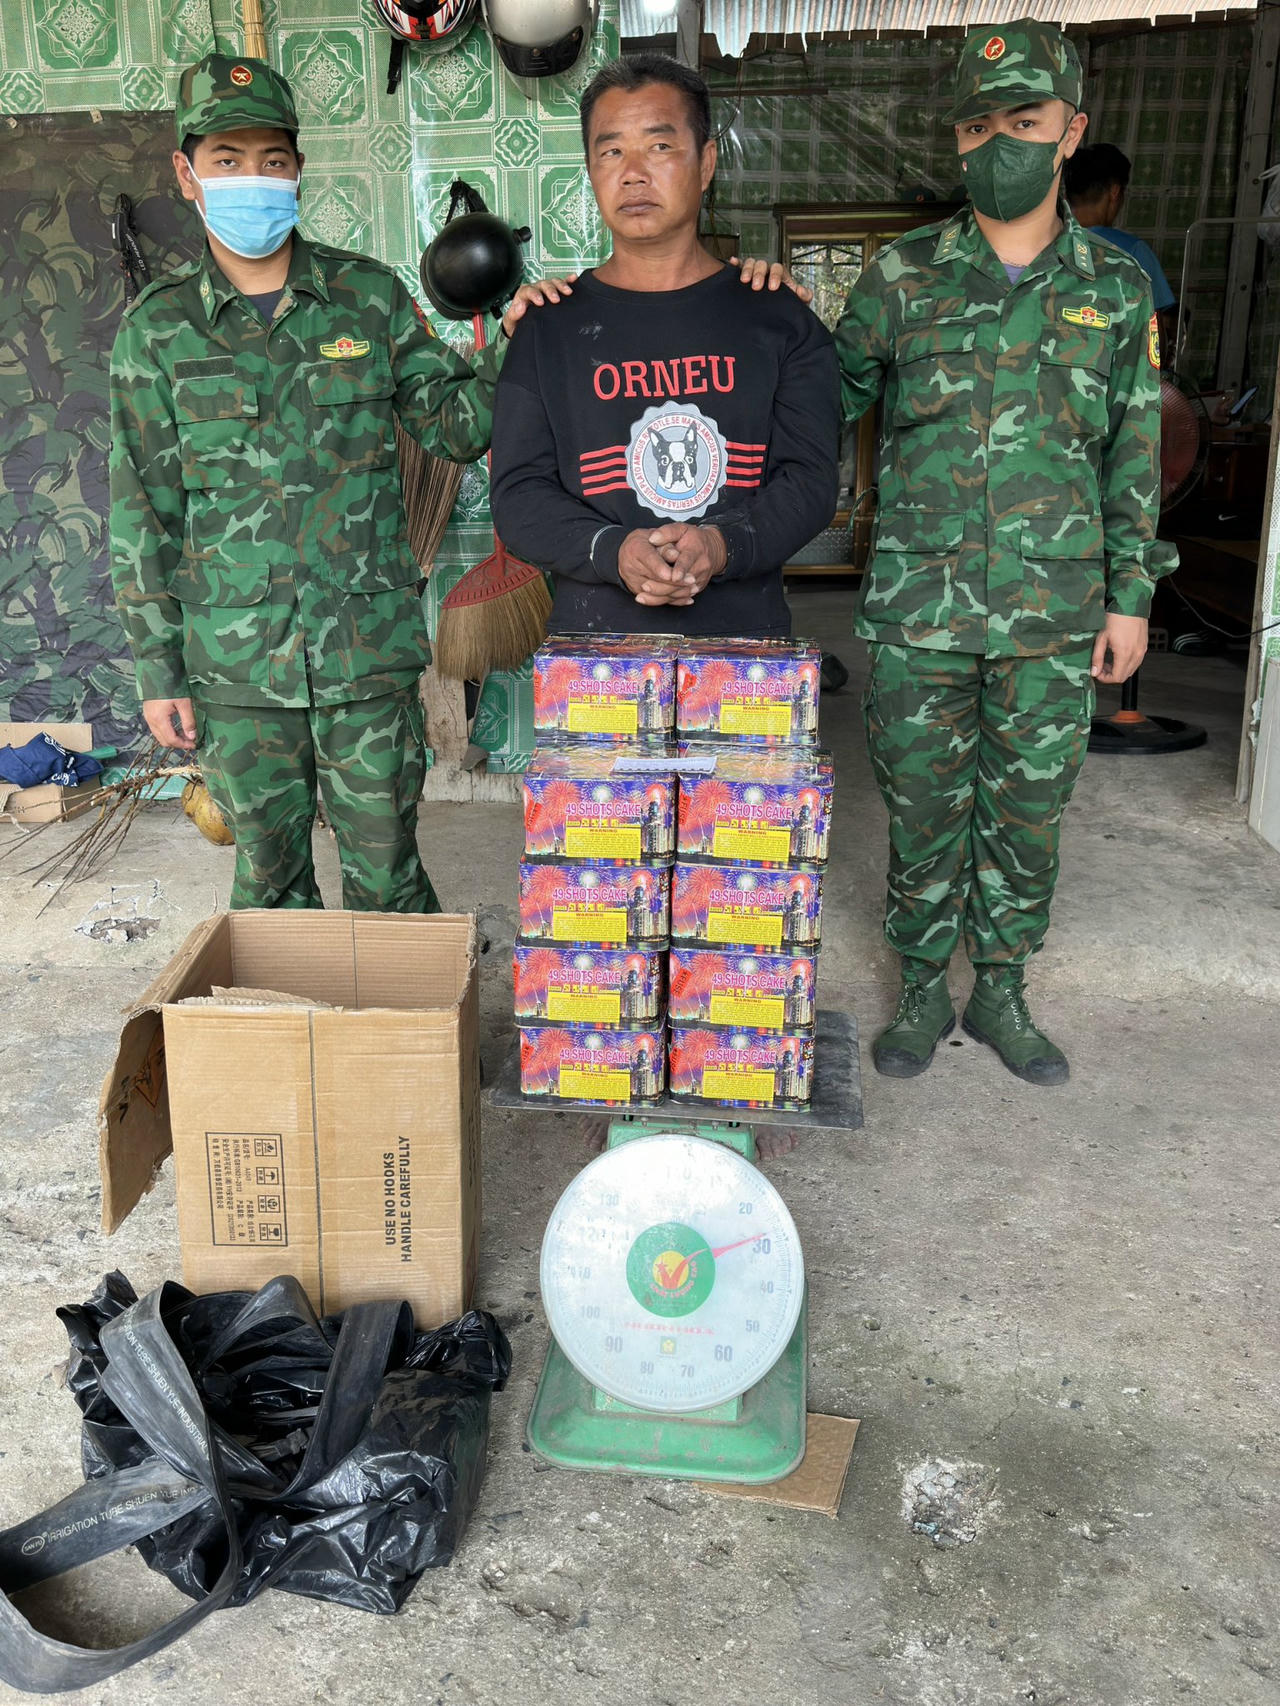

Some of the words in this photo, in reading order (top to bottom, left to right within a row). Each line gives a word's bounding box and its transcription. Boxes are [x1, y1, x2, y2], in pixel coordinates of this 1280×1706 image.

[593, 355, 735, 400] ORNEU
[710, 453, 718, 484] VERITAS
[568, 680, 580, 692] 49
[580, 680, 612, 694] SHOTS
[613, 680, 638, 694] CAKE
[722, 681, 734, 693] 49
[734, 681, 765, 694] SHOTS
[766, 682, 792, 696] CAKE
[566, 803, 579, 816] 49
[579, 803, 613, 817] SHOTS
[613, 804, 641, 817] CAKE
[716, 804, 728, 816] 49
[729, 804, 763, 818] SHOTS
[764, 806, 793, 819] CAKE
[553, 887, 564, 900] 49
[565, 887, 598, 900] SHOTS
[600, 888, 627, 902] CAKE
[709, 890, 722, 902] 49
[722, 890, 755, 903] SHOTS
[756, 891, 784, 905] CAKE
[548, 970, 560, 982] 49
[561, 970, 593, 983] SHOTS
[594, 970, 621, 984] CAKE
[712, 973, 724, 986] 49
[725, 974, 758, 988] SHOTS
[759, 976, 786, 990] CAKE
[560, 1048, 572, 1061] 49
[572, 1049, 604, 1062] SHOTS
[605, 1050, 630, 1064] CAKE
[704, 1048, 716, 1061] 49
[717, 1049, 749, 1062] SHOTS
[750, 1050, 776, 1064] CAKE
[383, 1152, 395, 1196] HOOKS
[399, 1136, 411, 1208] CAREFULLY
[600, 1192, 619, 1207] 130
[385, 1200, 396, 1217] NO
[739, 1201, 753, 1215] 20
[385, 1220, 396, 1245] USE
[401, 1211, 411, 1262] HANDLE
[752, 1238, 772, 1255] 30
[760, 1280, 774, 1294] 40
[581, 1305, 601, 1319] 100
[745, 1320, 760, 1333] 50
[606, 1335, 623, 1353] 90
[714, 1344, 733, 1362] 60
[135, 1343, 152, 1367] TUBE
[147, 1364, 170, 1392] SHUEN
[640, 1361, 654, 1374] 80
[681, 1364, 695, 1378] 70
[47, 1515, 98, 1543] IRRIGATION
[100, 1504, 124, 1522] TUBE
[125, 1491, 157, 1512] SHUEN
[161, 1490, 178, 1499] YUE
